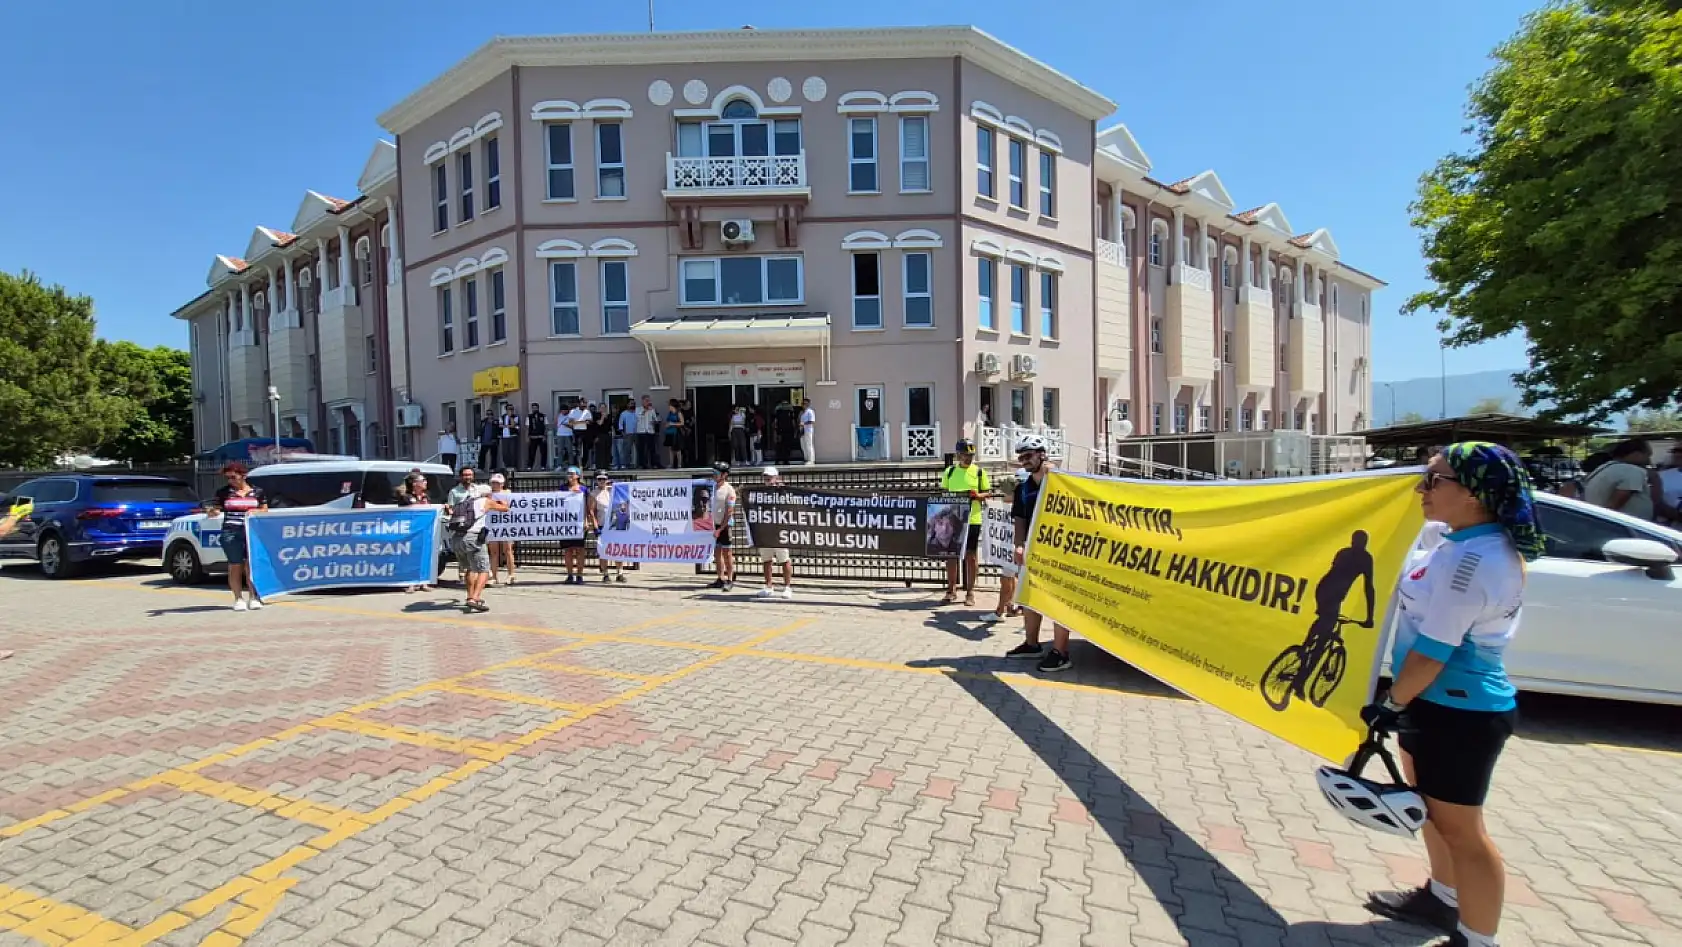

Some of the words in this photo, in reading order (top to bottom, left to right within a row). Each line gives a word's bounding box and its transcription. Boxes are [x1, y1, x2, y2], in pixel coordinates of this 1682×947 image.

[657, 486, 687, 498] ALKAN
[509, 497, 528, 508] AĞ
[531, 497, 565, 511] ŞERİT
[653, 500, 663, 508] ve
[491, 509, 578, 523] BİSİKLETLİNİN
[749, 506, 831, 527] BİSİKLETLİ
[835, 509, 916, 530] ÖLÜMLER
[988, 507, 1013, 523] BİSİK
[1044, 490, 1098, 521] BİSİKLET
[1097, 501, 1182, 541] TAŞITTIR,
[282, 517, 411, 539] BİSİKLETİME
[492, 526, 533, 537] YASAL
[536, 525, 577, 536] HAKKI
[989, 523, 1013, 544] ÖLÜM
[208, 533, 221, 545] PO
[779, 530, 811, 545] SON
[815, 532, 879, 549] BULSUN
[278, 541, 411, 565] ÇARPARSAN
[605, 542, 646, 557] ADALET
[990, 544, 1013, 563] DURS
[293, 560, 395, 581] ÖLÜRÜM!
[1037, 522, 1063, 547] SAĞ
[1063, 528, 1107, 560] ŞERİT
[1108, 540, 1161, 577] YASAL
[1166, 553, 1308, 614] HAKKIDIR!
